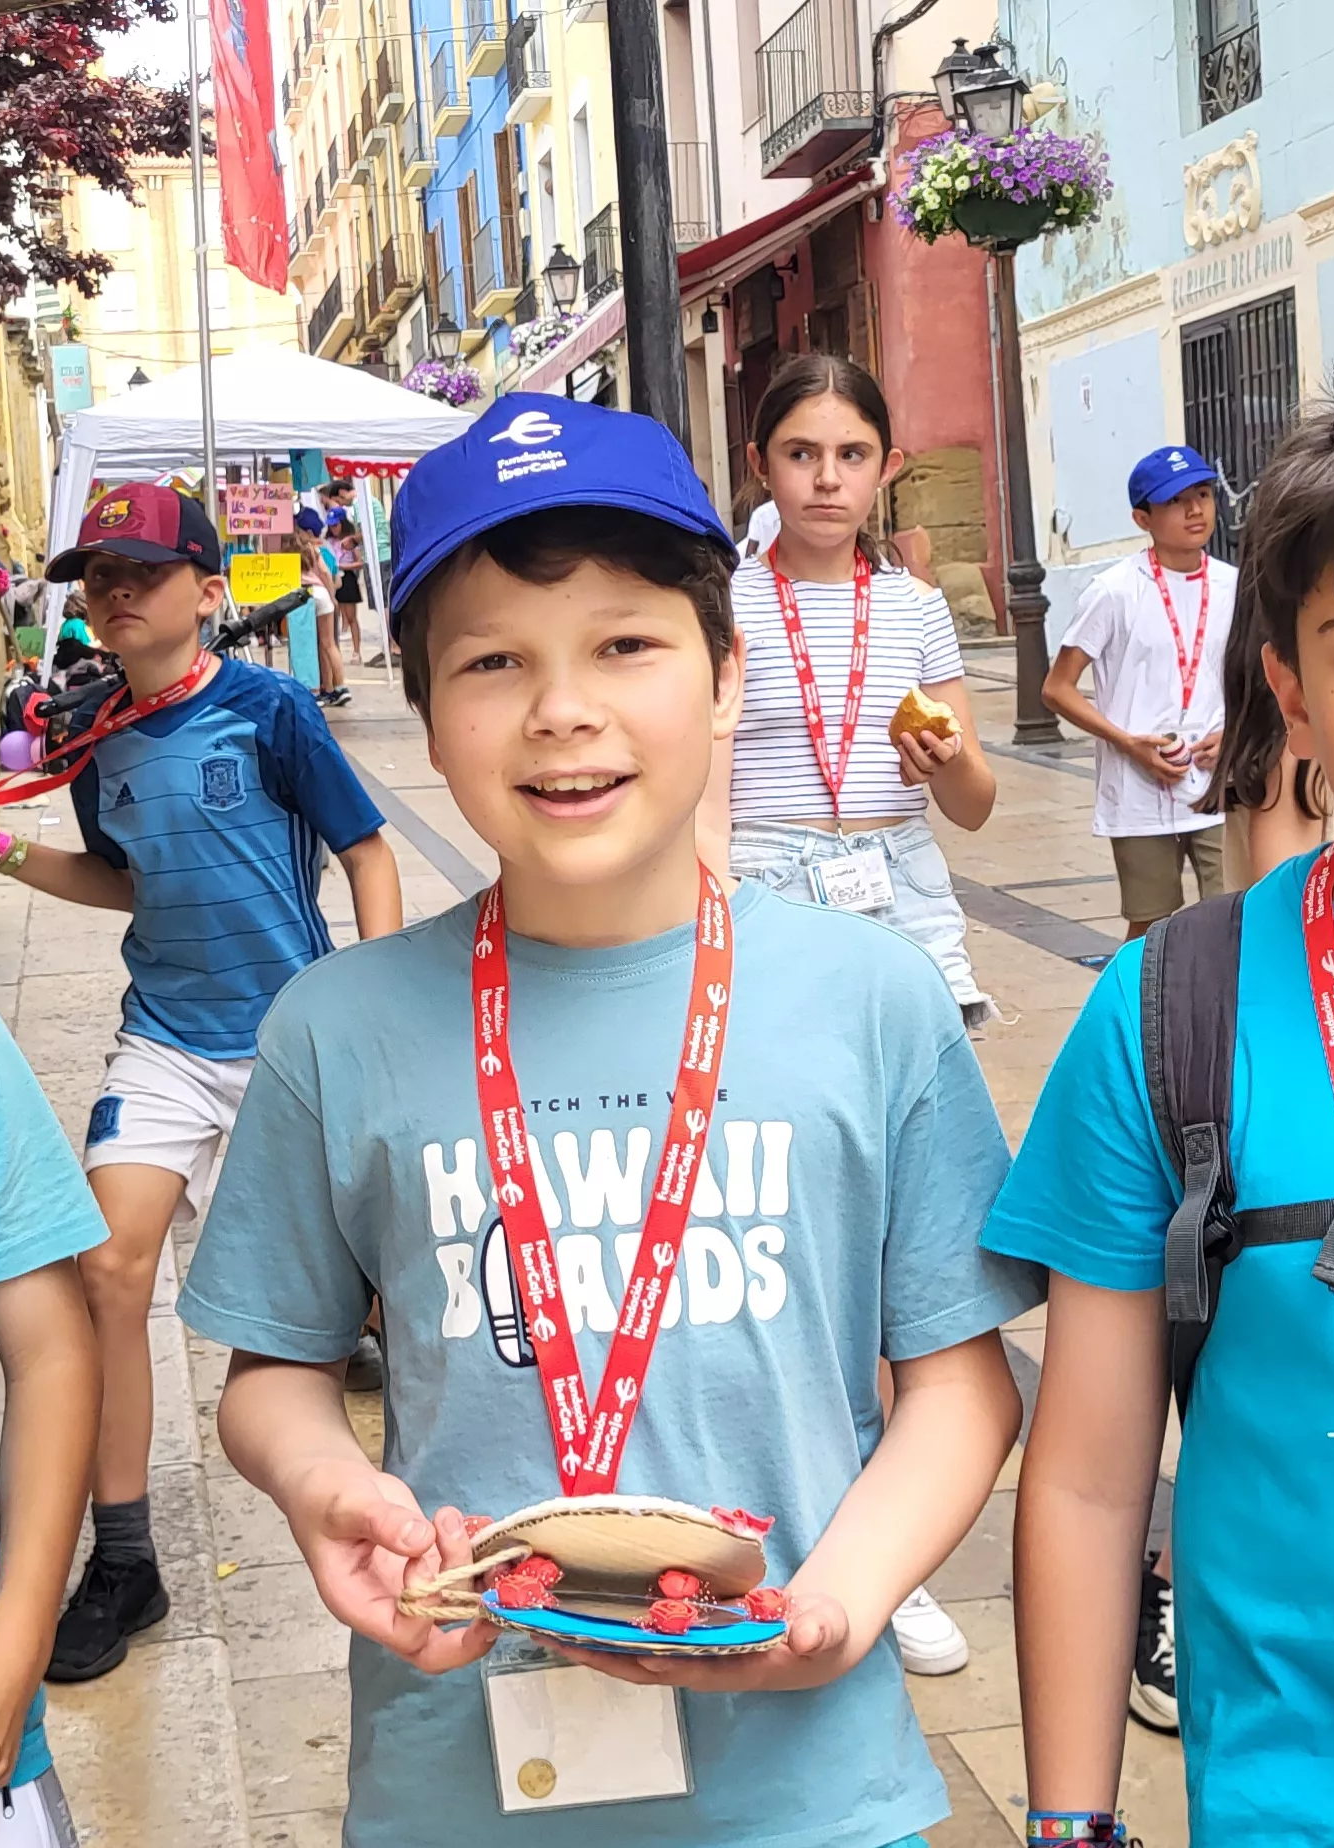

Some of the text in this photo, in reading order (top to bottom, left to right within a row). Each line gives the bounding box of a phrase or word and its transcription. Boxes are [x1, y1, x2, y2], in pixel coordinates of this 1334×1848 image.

[599, 1093, 648, 1110] THE
[507, 1106, 524, 1165] Fundación
[656, 1142, 680, 1202] Fundación
[535, 1239, 556, 1299] Fundación
[620, 1276, 645, 1336] Fundación
[567, 1374, 588, 1435] Fundación
[583, 1411, 608, 1472] Fundación
